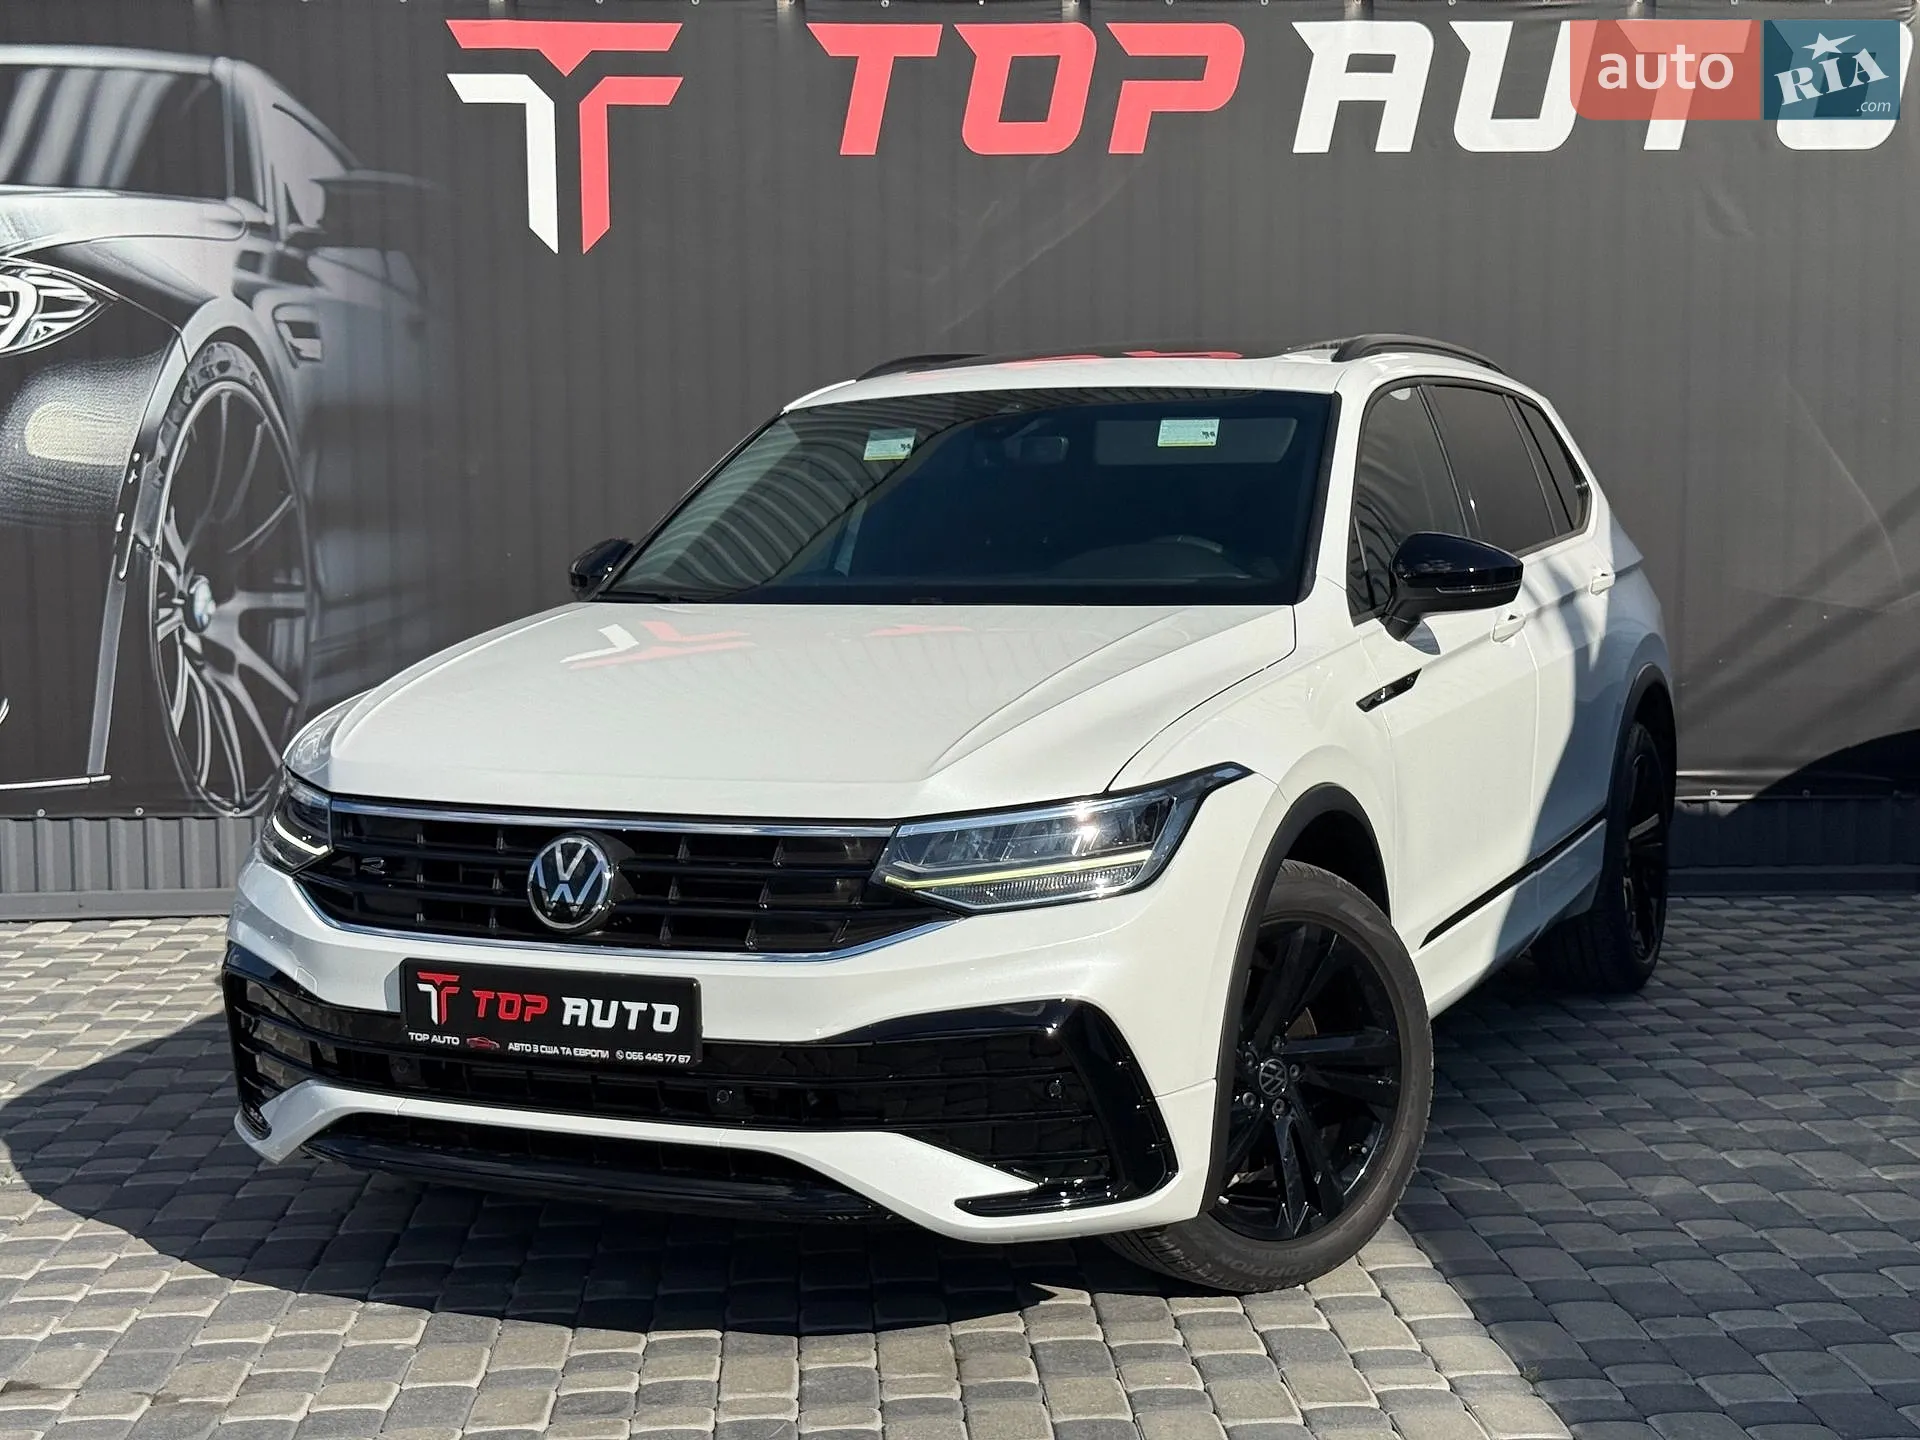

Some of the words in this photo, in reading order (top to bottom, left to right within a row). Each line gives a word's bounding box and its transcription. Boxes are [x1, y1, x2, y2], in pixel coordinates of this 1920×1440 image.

[806, 23, 1246, 155] TOP
[1291, 19, 1914, 153] AUTO
[472, 989, 549, 1022] TOP
[561, 996, 680, 1033] AUTO
[408, 1031, 430, 1042] TOP
[431, 1034, 460, 1046] AUTO
[508, 1042, 532, 1053] АВТО
[645, 1052, 664, 1062] 445
[664, 1053, 677, 1063] 77
